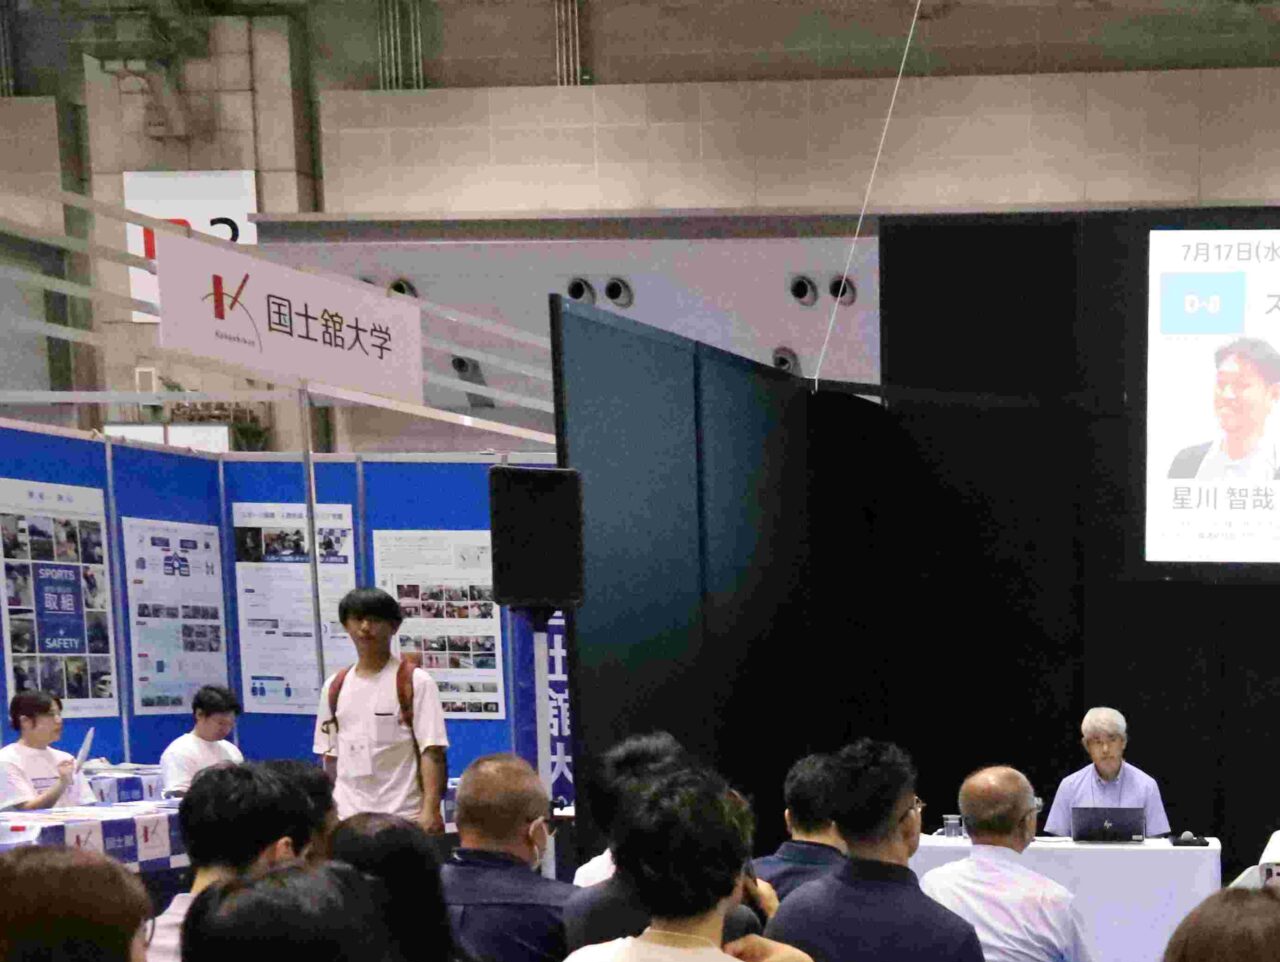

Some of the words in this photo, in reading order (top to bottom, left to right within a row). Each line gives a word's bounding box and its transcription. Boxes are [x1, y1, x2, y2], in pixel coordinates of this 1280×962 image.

[267, 294, 392, 360] 国士舘大学
[1172, 486, 1219, 511] 星川
[1226, 486, 1276, 511] 智哉
[38, 568, 75, 580] SPORTS
[45, 638, 79, 650] SAFETY
